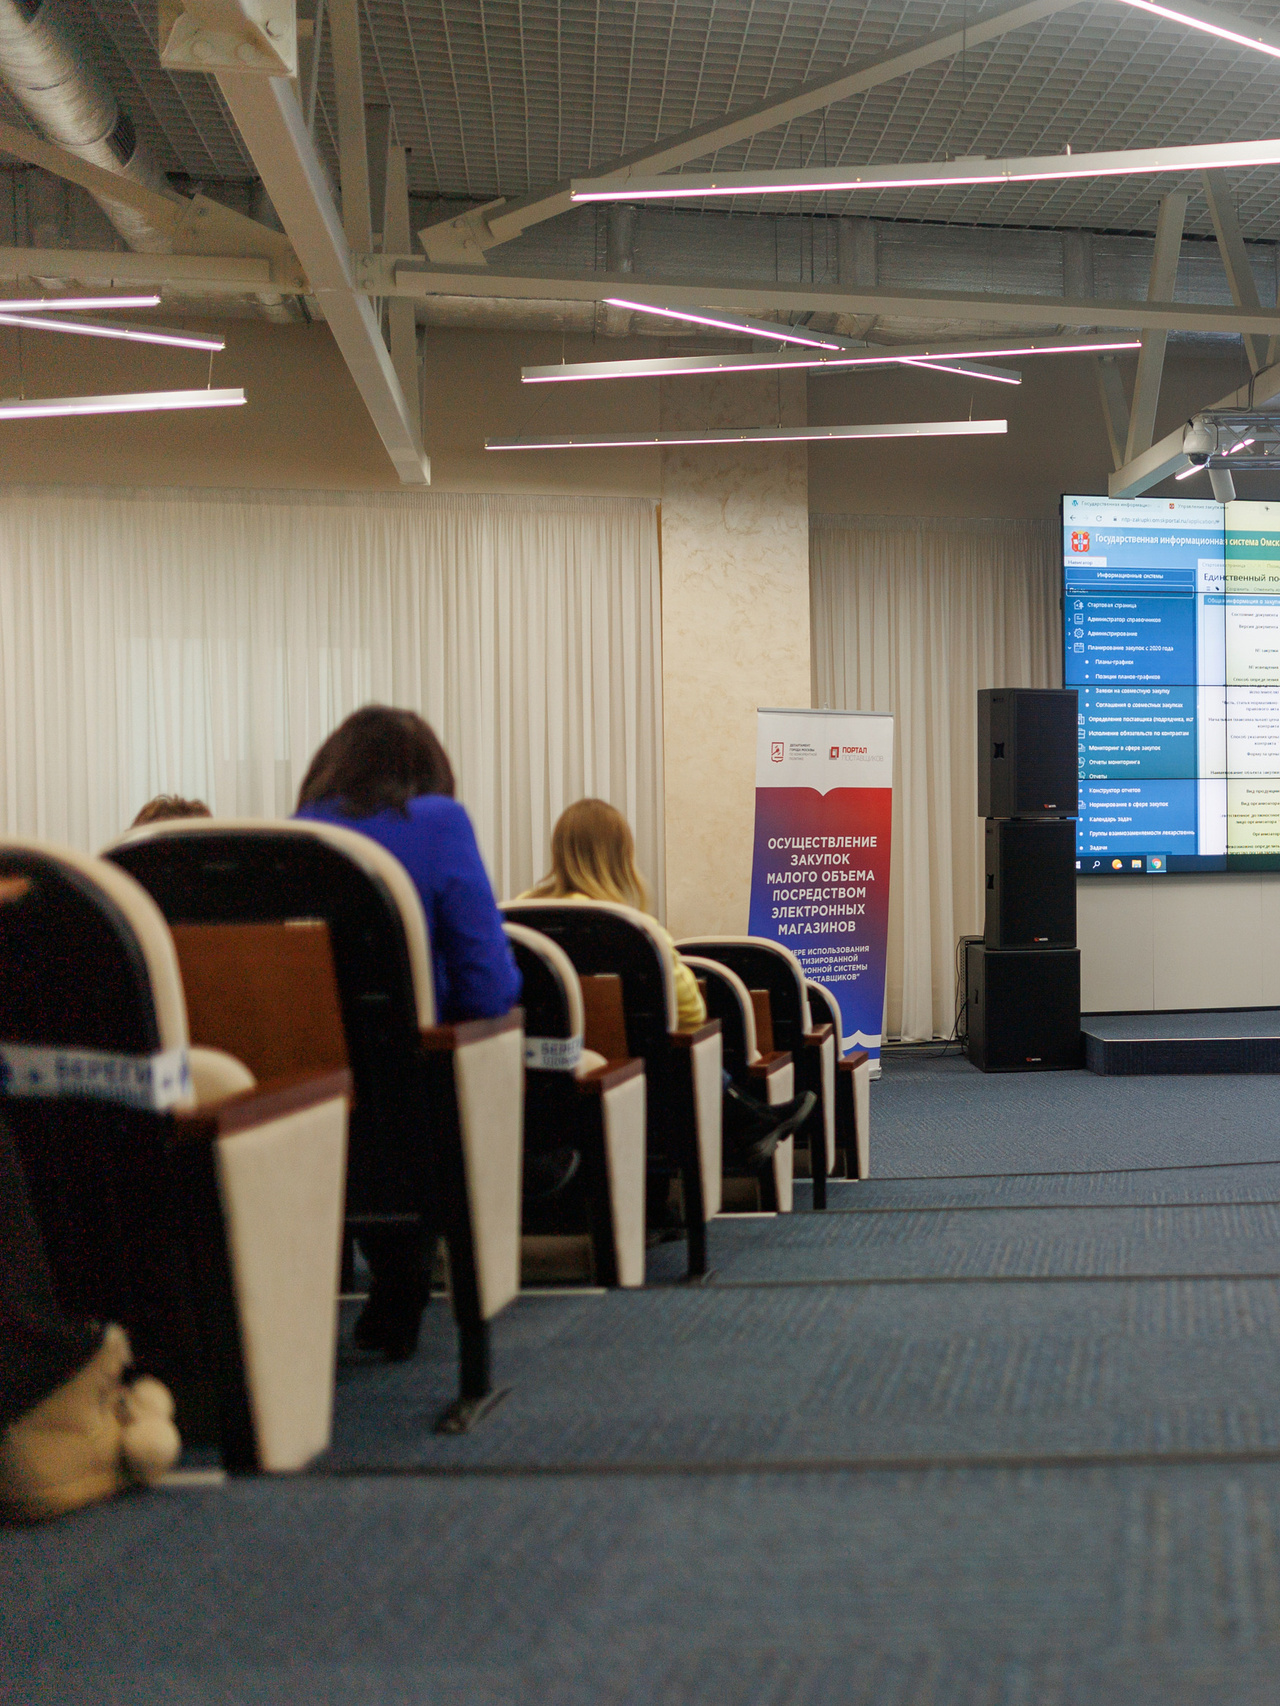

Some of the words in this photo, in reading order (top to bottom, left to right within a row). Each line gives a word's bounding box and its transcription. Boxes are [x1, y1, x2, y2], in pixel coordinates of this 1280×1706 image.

[1095, 534, 1158, 545] Государственная
[1160, 536, 1228, 546] информационная
[1230, 539, 1259, 547] система
[1204, 573, 1266, 582] Единственный
[768, 837, 877, 850] ОСУЩЕСТВЛЕНИЕ
[790, 854, 850, 866] ЗАКУПОК
[767, 871, 817, 884] МАЛОГО
[822, 870, 875, 882] ОБЪЕМА
[773, 887, 866, 901] ПОСРЕДСТВОМ
[771, 904, 865, 918] ЭЛЕКТРОННЫХ
[778, 921, 856, 935] МАГАЗИНОВ
[808, 946, 869, 955] ИСПОЛЬЗОВАНИЯ
[834, 964, 868, 972] СИСТЕМЫ
